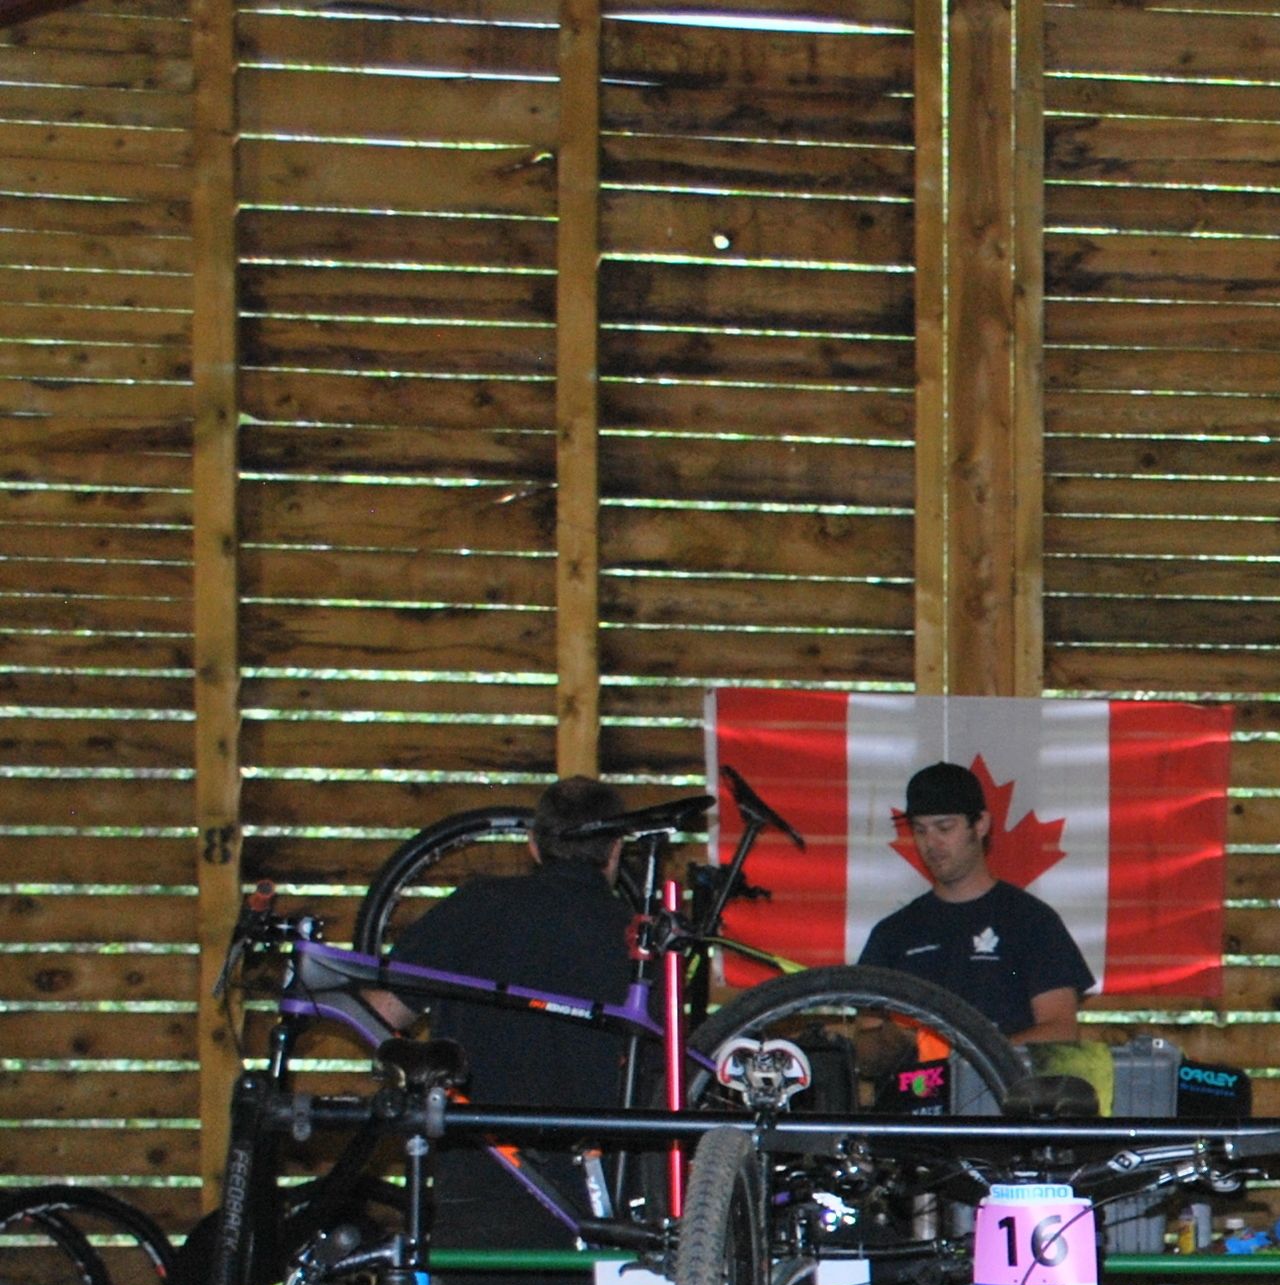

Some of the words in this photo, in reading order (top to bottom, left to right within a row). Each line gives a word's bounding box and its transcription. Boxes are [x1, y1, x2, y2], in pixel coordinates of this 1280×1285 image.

[1180, 1066, 1238, 1088] OAKLEY
[991, 1185, 1069, 1199] SHIMANO
[998, 1214, 1069, 1267] 16
